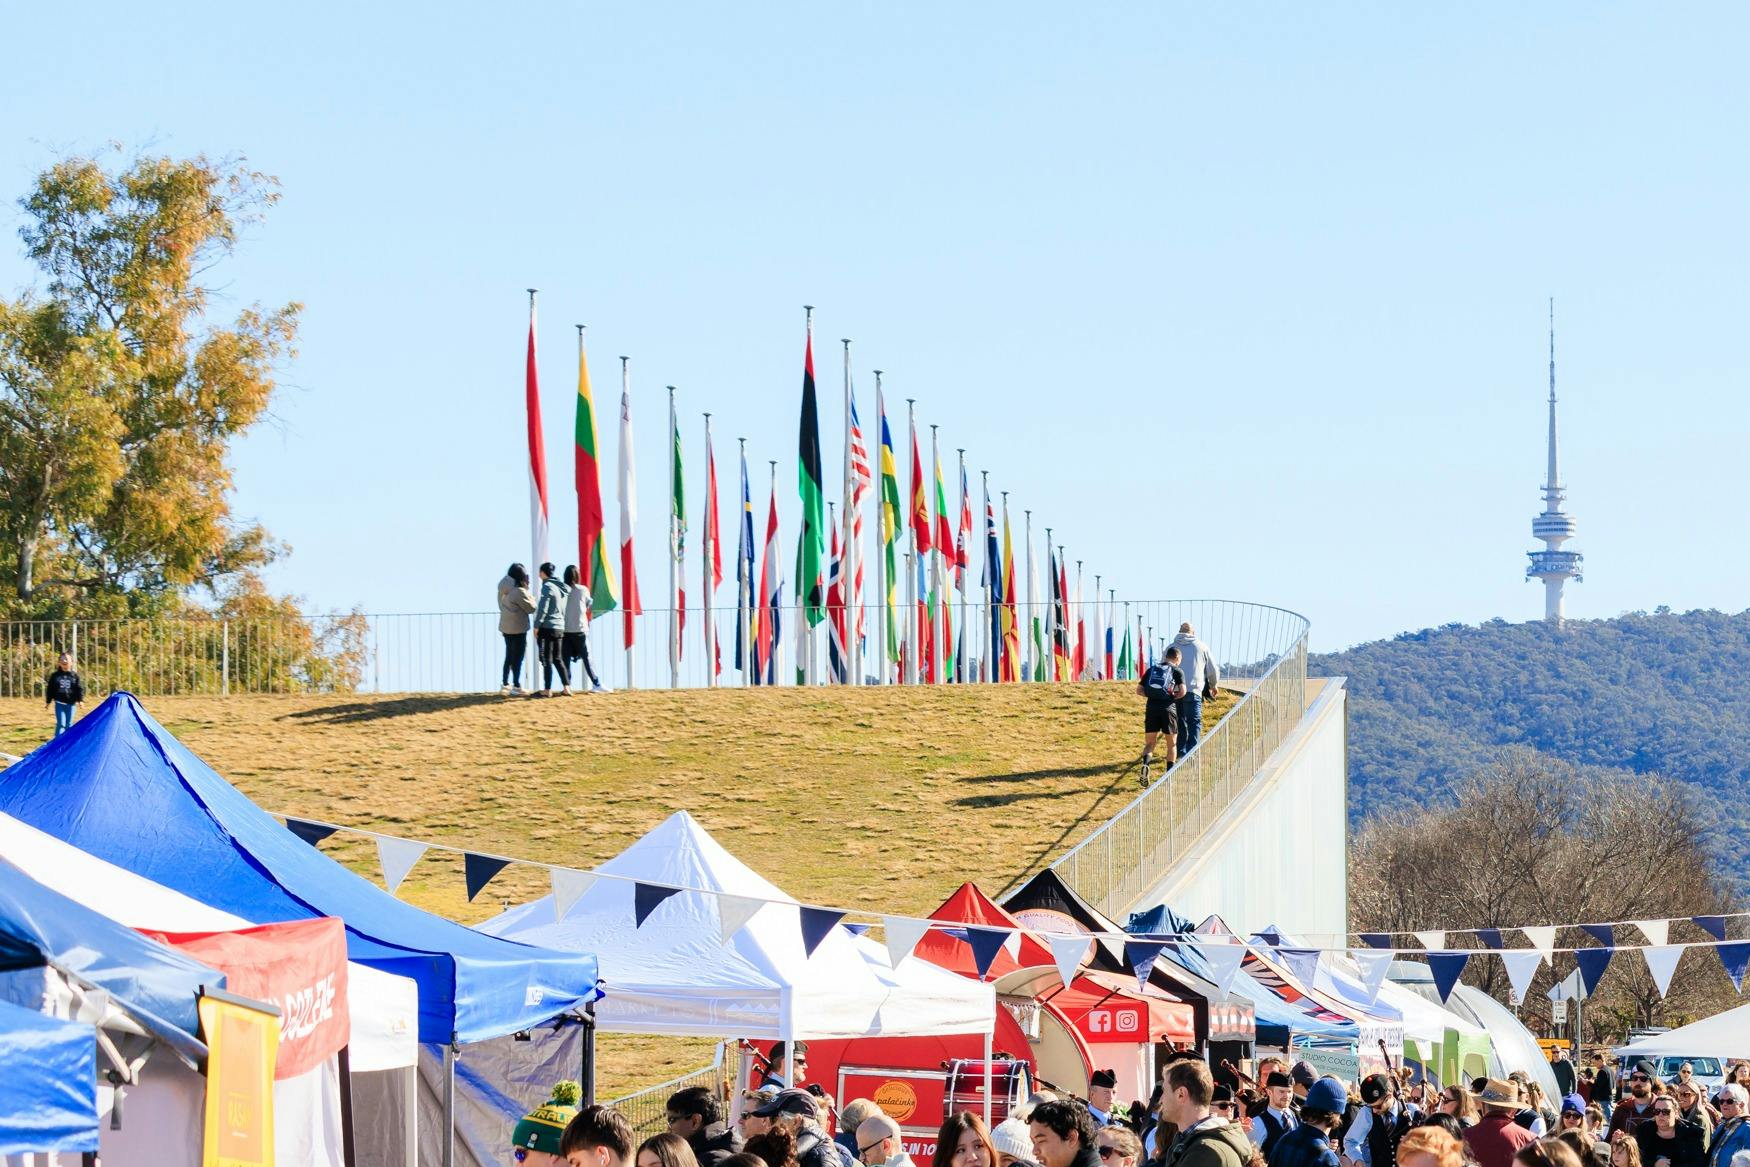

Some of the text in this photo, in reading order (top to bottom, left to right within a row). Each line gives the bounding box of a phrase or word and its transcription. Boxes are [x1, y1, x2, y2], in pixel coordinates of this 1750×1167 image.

[1301, 1052, 1358, 1067] STUDIO COCOA
[908, 1142, 921, 1155] IN
